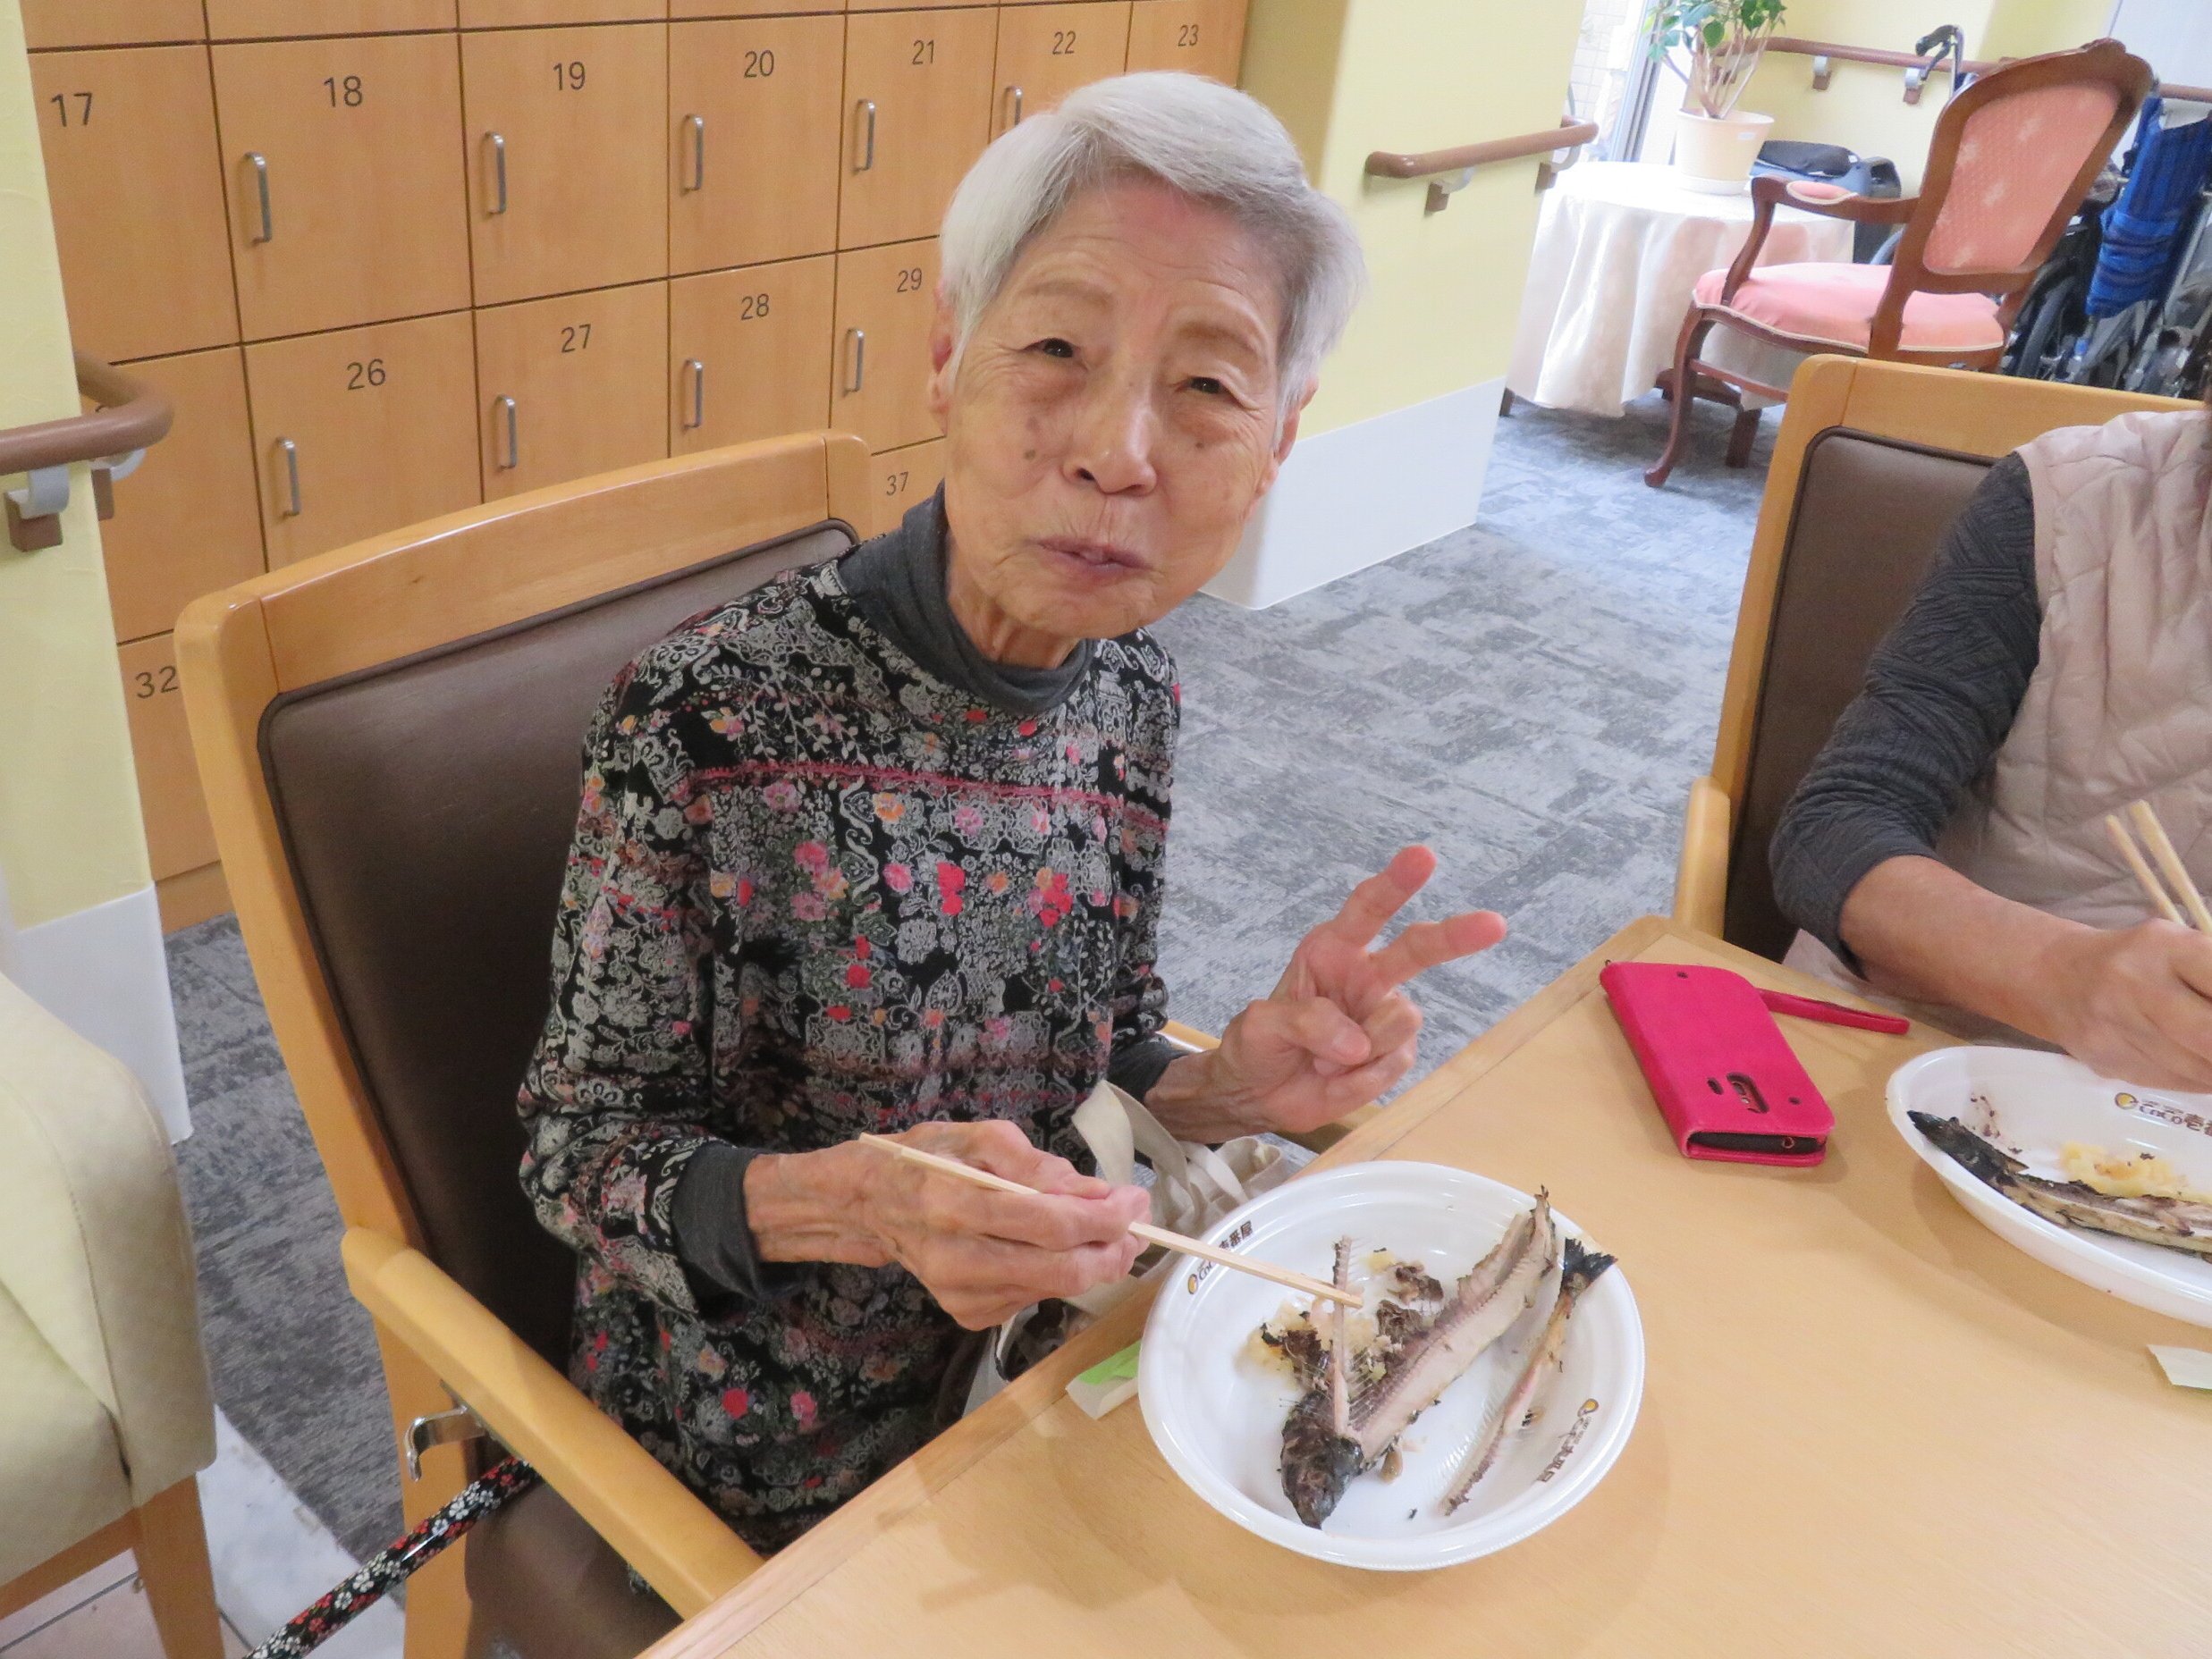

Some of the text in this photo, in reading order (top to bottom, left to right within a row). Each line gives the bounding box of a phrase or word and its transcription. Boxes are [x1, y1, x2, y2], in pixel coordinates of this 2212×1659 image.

[1051, 29, 1076, 55] 22
[1178, 23, 1200, 47] 23
[743, 49, 775, 79] 20
[911, 39, 935, 65] 21
[553, 61, 587, 91] 19
[323, 75, 363, 108] 18
[50, 91, 94, 128] 17
[896, 267, 923, 293] 29
[740, 293, 770, 321] 28
[560, 323, 592, 354] 27
[346, 358, 386, 391] 26
[886, 471, 909, 496] 37
[135, 665, 179, 699] 32
